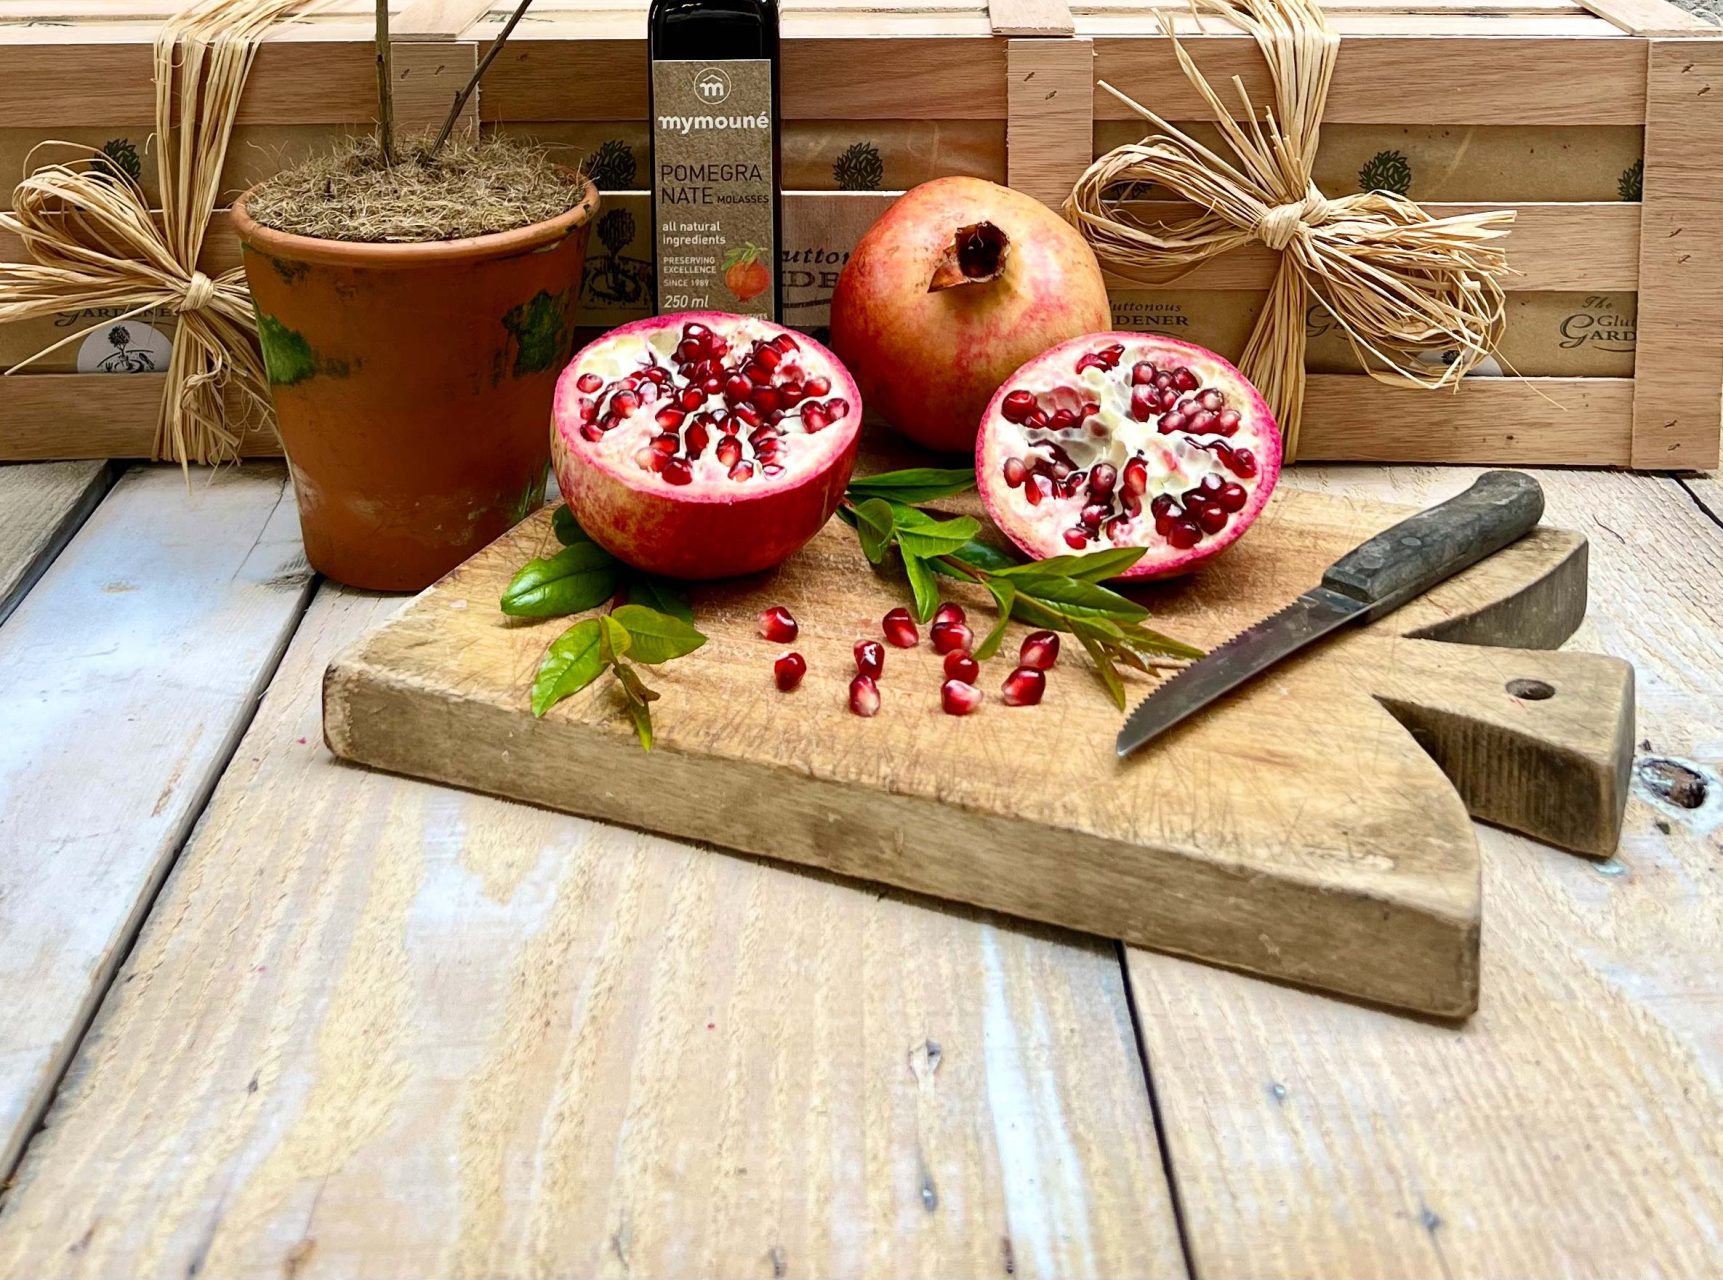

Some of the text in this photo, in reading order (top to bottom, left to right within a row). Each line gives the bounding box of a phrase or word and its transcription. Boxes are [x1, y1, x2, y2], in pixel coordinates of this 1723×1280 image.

[657, 111, 769, 134] mymouné
[661, 164, 763, 182] POMEGRA
[661, 186, 769, 204] NATE MOLASSES
[662, 221, 721, 232] all natural
[662, 234, 726, 248] ingredients
[663, 256, 716, 265] PRESERVING
[663, 265, 717, 274] EXCELLENCE
[663, 279, 709, 287] SINCE 1989
[663, 294, 709, 309] 250 ml
[1581, 295, 1613, 309] The
